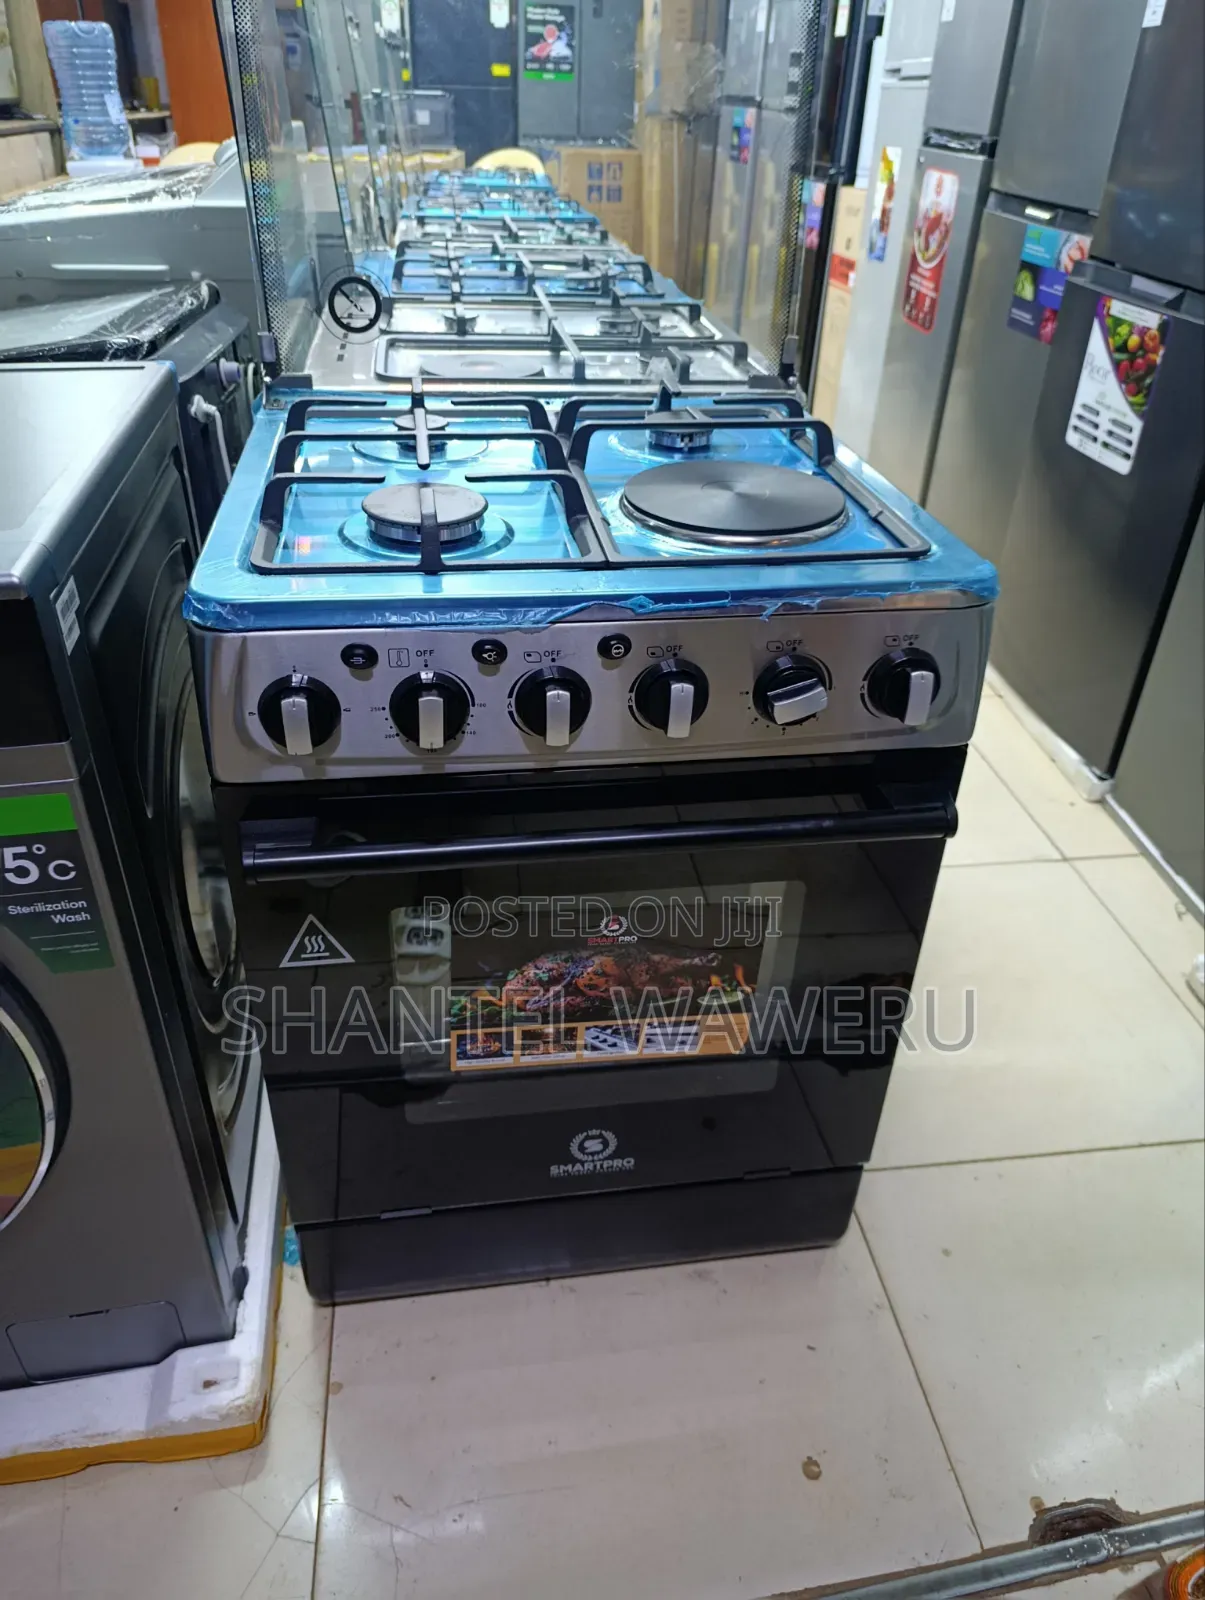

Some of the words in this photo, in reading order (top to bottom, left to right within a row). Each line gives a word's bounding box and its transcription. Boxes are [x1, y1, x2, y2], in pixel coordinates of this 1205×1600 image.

[786, 639, 803, 647] OFF
[415, 649, 435, 658] OFF
[665, 645, 683, 653] OFF
[543, 650, 562, 658] OFF
[0, 843, 77, 885] 5°C
[7, 900, 88, 915] Sterilization
[51, 911, 91, 924] Wash
[587, 935, 638, 943] SMARTPRO
[549, 1157, 635, 1174] SMARTPRO
